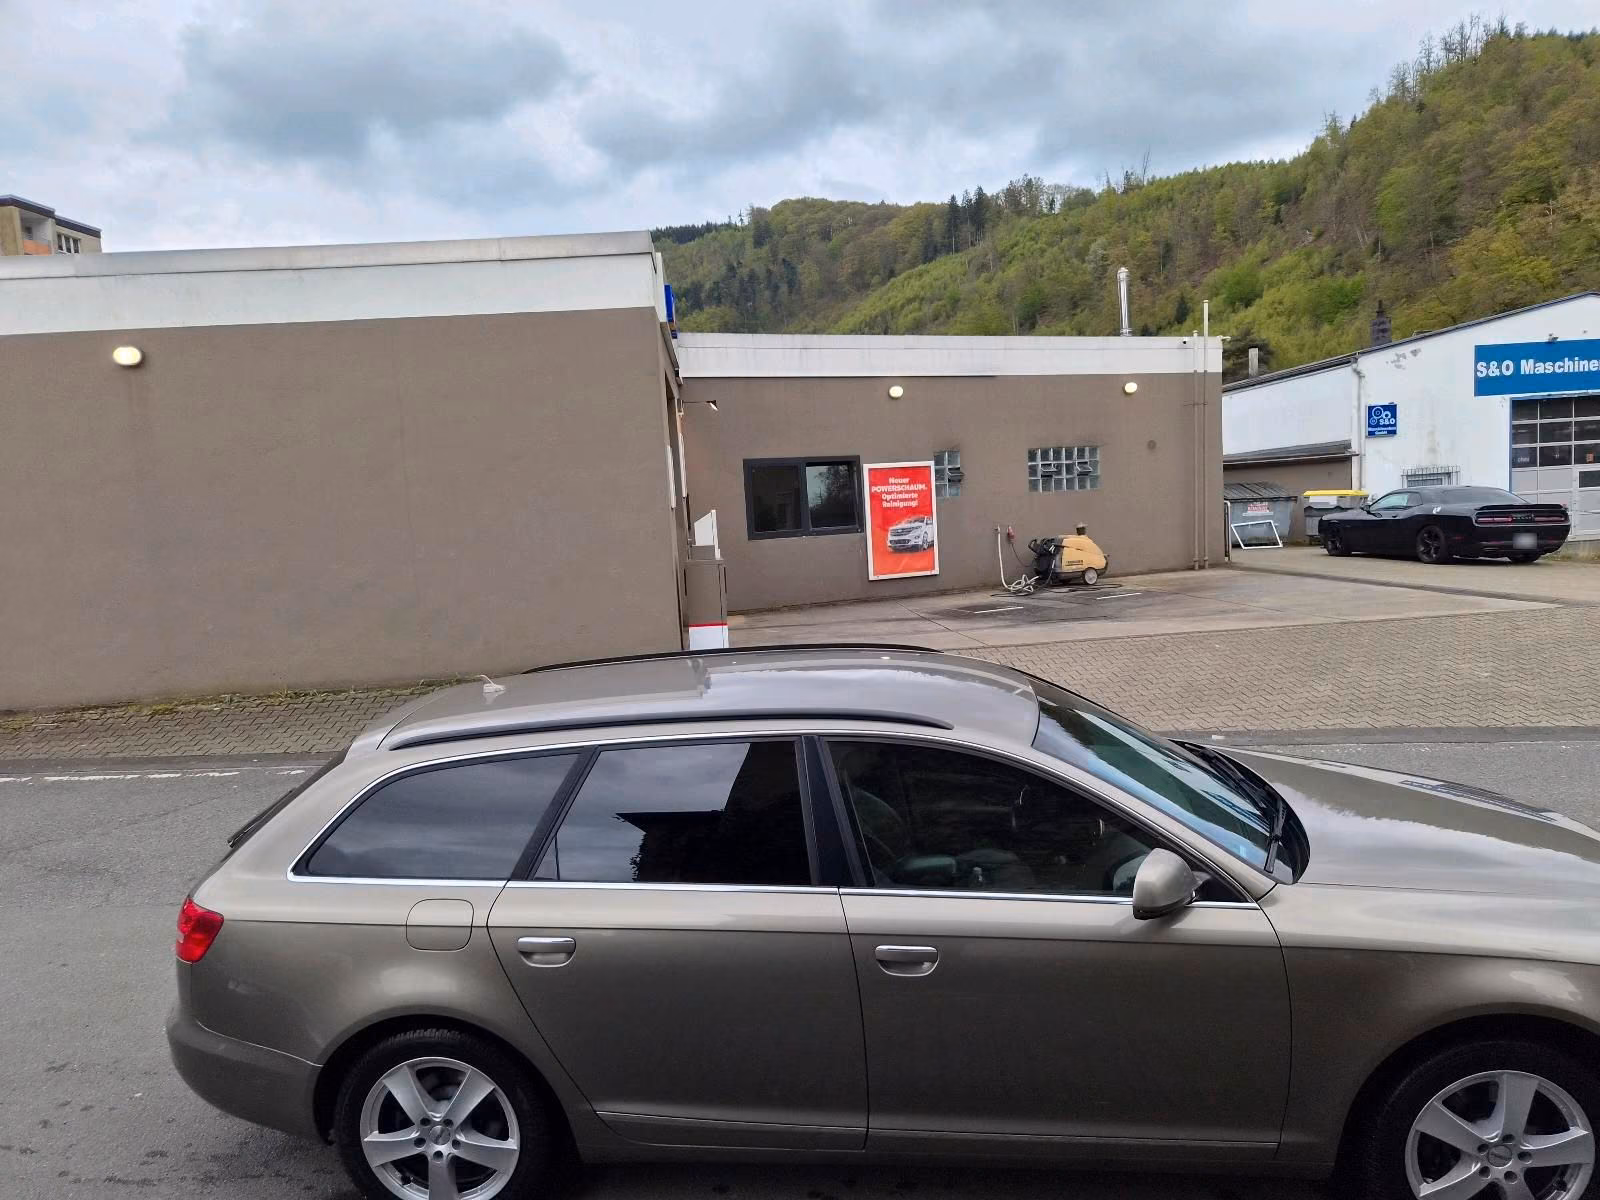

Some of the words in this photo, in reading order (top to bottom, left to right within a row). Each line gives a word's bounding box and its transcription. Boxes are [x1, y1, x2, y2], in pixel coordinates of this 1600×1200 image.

[1476, 360, 1514, 377] S&O
[1520, 357, 1600, 375] Maschine
[882, 493, 918, 501] Optimierte
